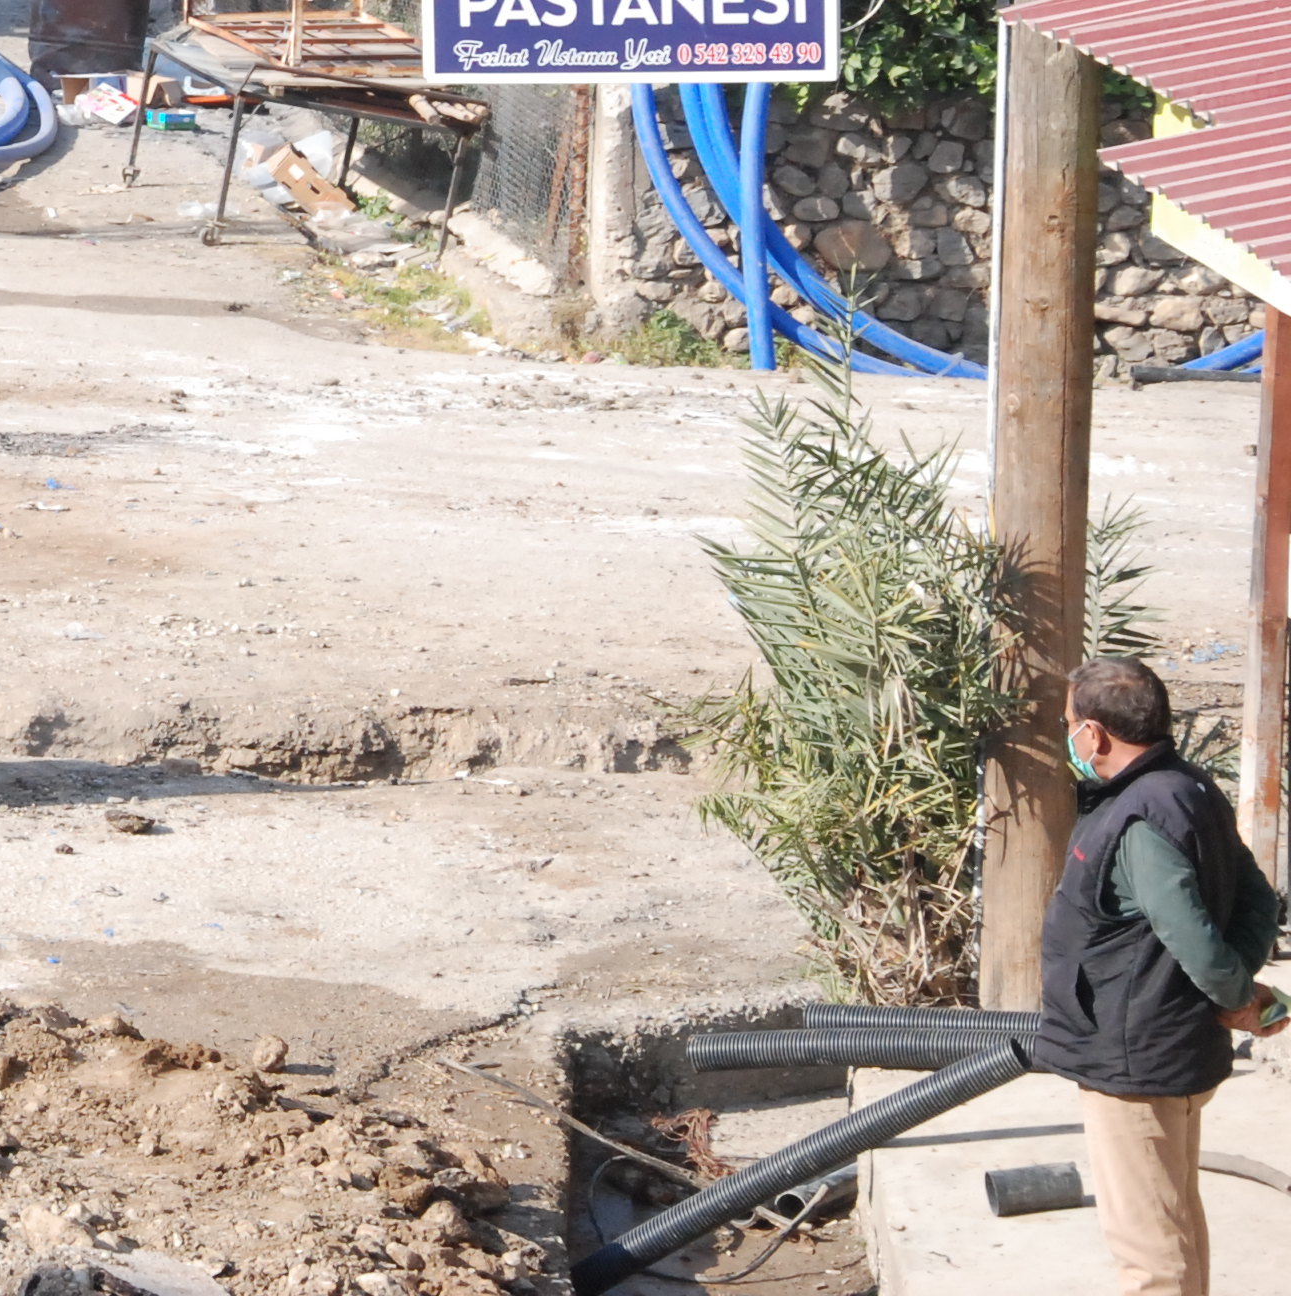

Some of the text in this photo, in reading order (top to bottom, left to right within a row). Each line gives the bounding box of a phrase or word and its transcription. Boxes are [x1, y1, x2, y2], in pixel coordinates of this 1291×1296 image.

[453, 39, 529, 70] Ferhat
[620, 37, 672, 70] Yeri
[677, 43, 692, 65] 0
[693, 43, 728, 64] 542
[731, 42, 767, 64] 328
[769, 42, 793, 64] 43
[796, 42, 822, 64] 90
